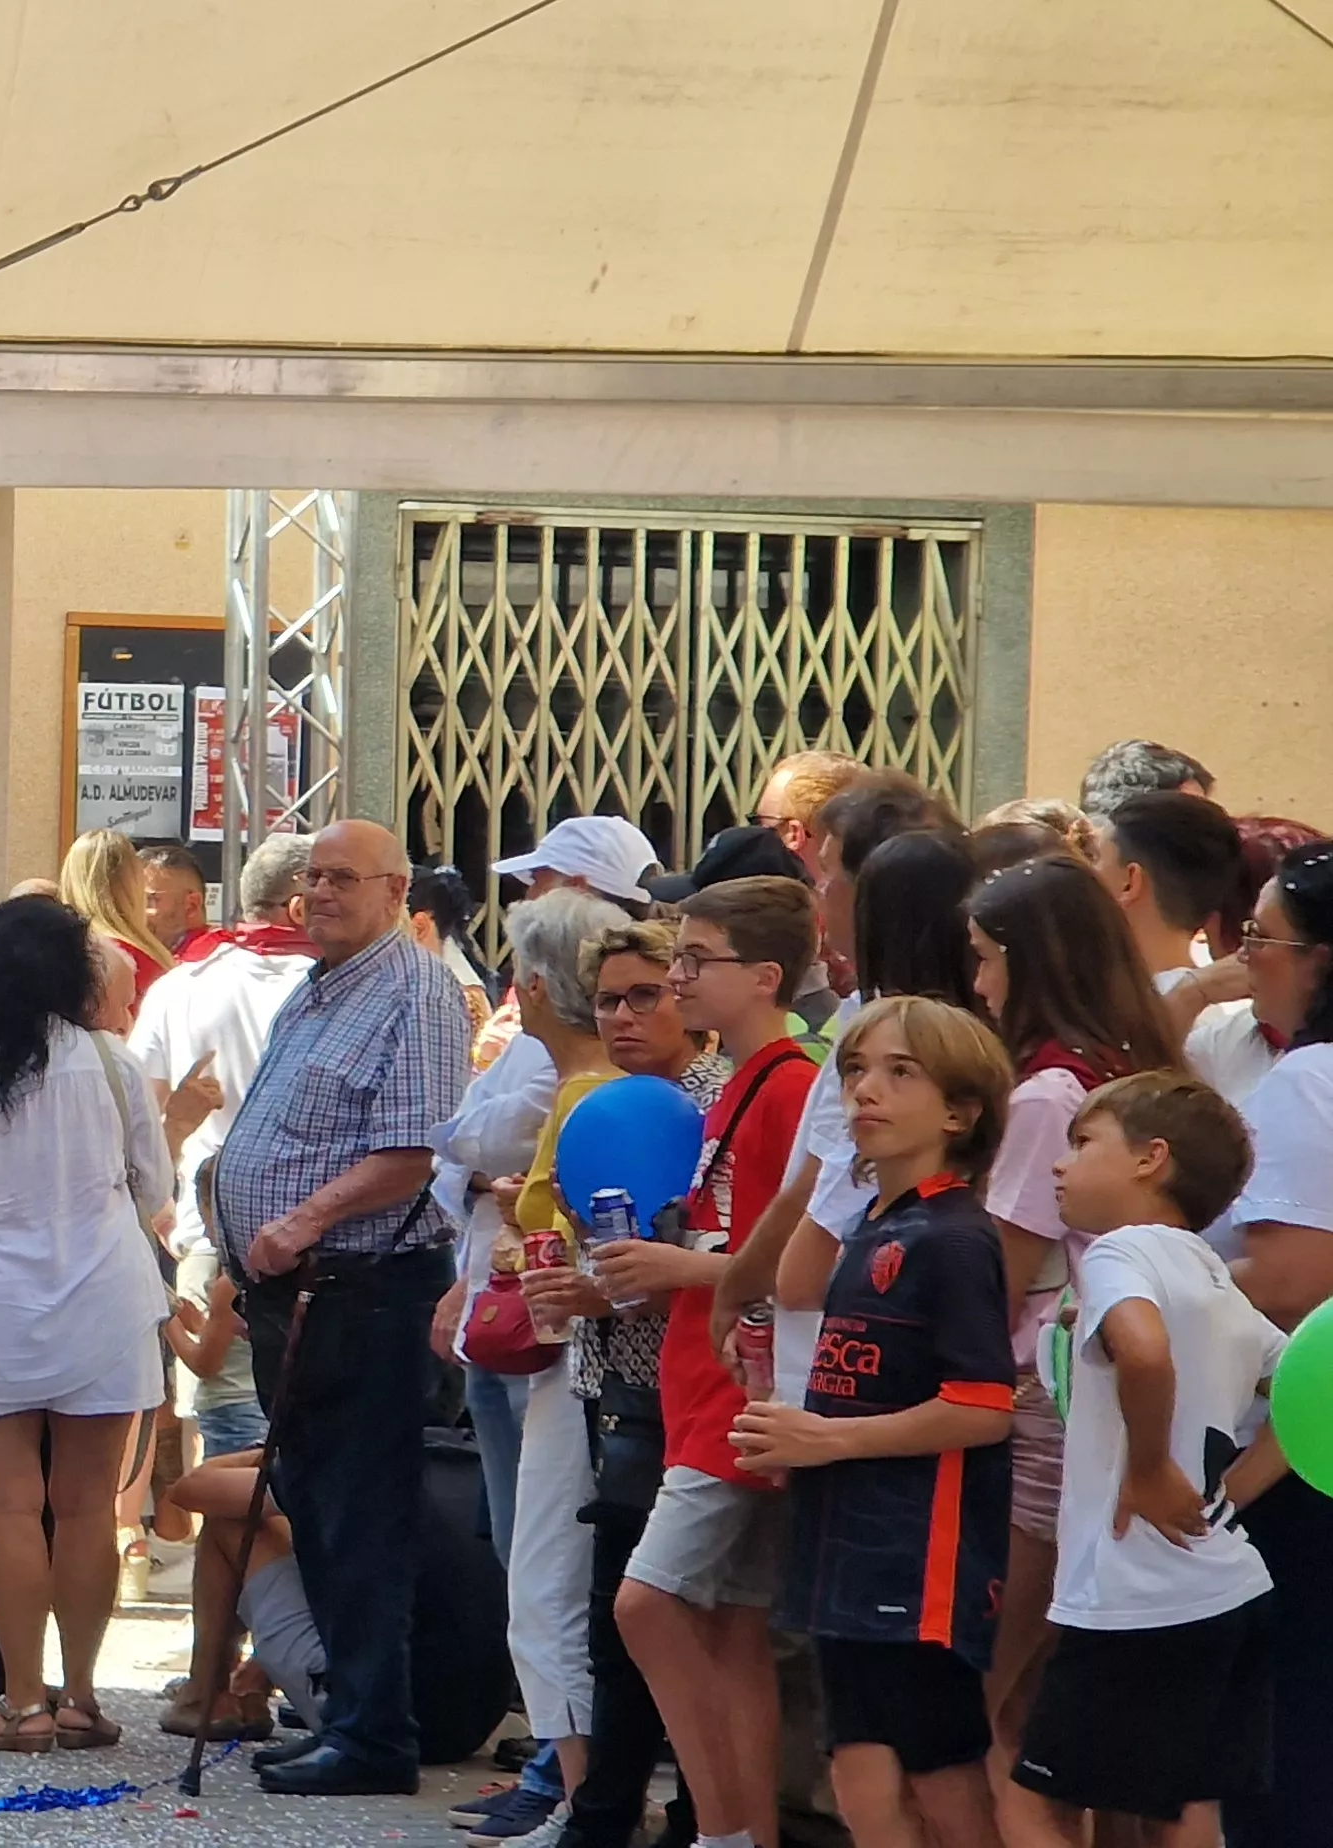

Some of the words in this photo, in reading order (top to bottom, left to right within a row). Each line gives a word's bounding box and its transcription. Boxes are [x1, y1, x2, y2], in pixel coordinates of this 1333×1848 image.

[83, 688, 178, 712] FÚTBOL
[81, 784, 105, 800] A.D.
[109, 784, 177, 801] ALMUDEVAR
